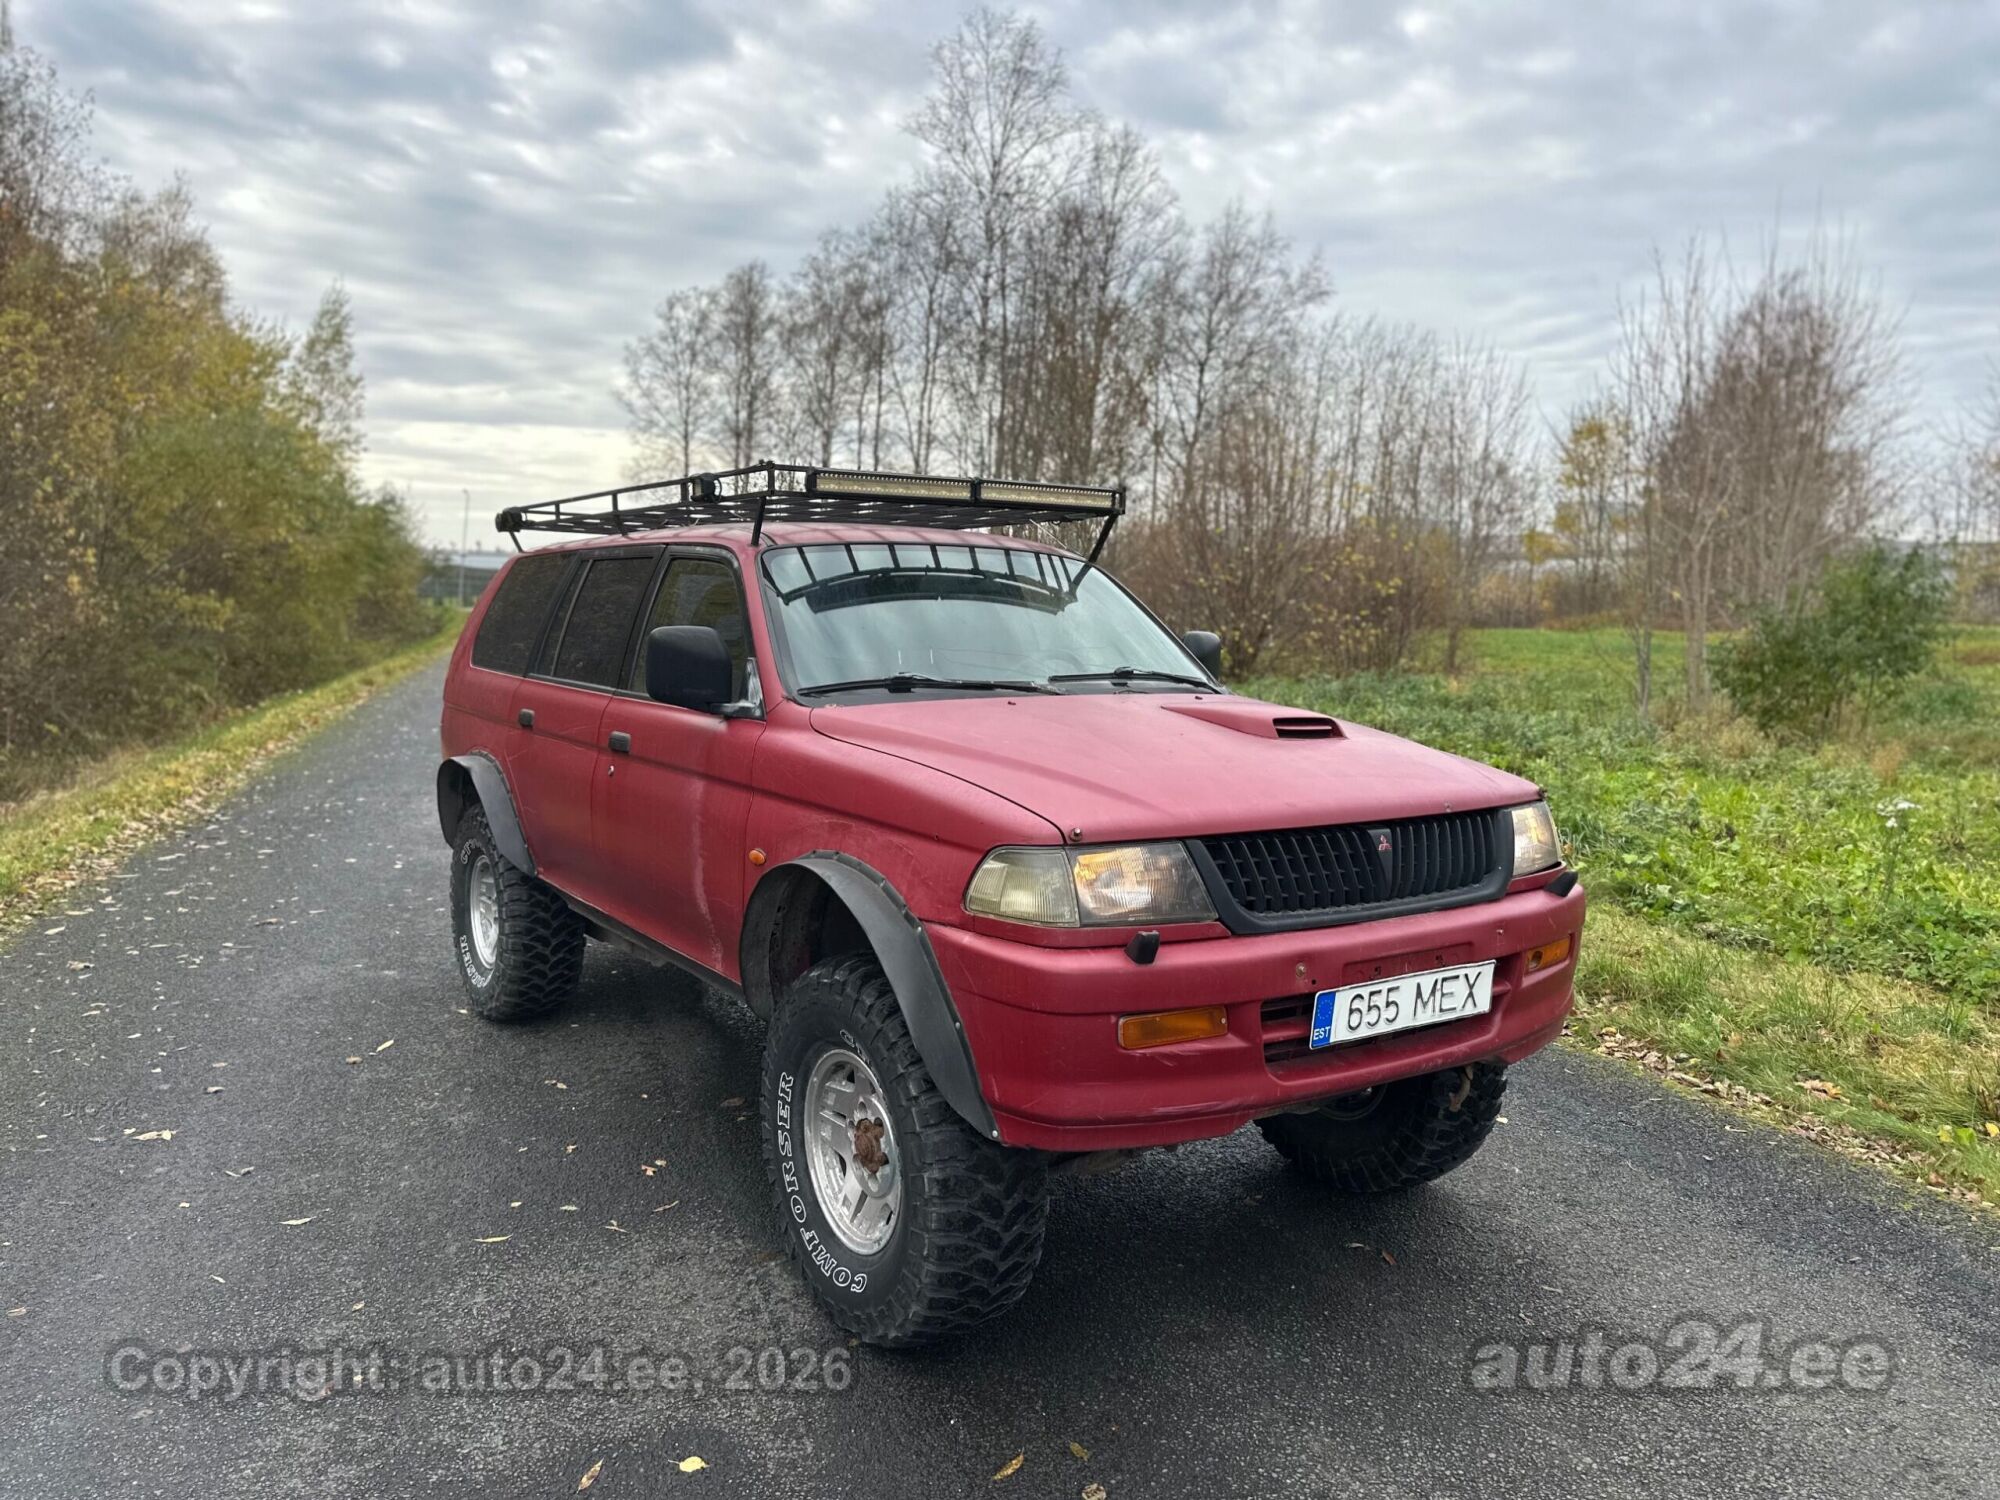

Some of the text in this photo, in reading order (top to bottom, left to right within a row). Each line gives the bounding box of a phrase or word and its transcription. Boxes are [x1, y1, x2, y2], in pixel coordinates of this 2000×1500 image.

[1347, 971, 1482, 1031] 655 MEX
[1313, 1025, 1331, 1040] EST
[777, 1071, 868, 1293] COMFORSER
